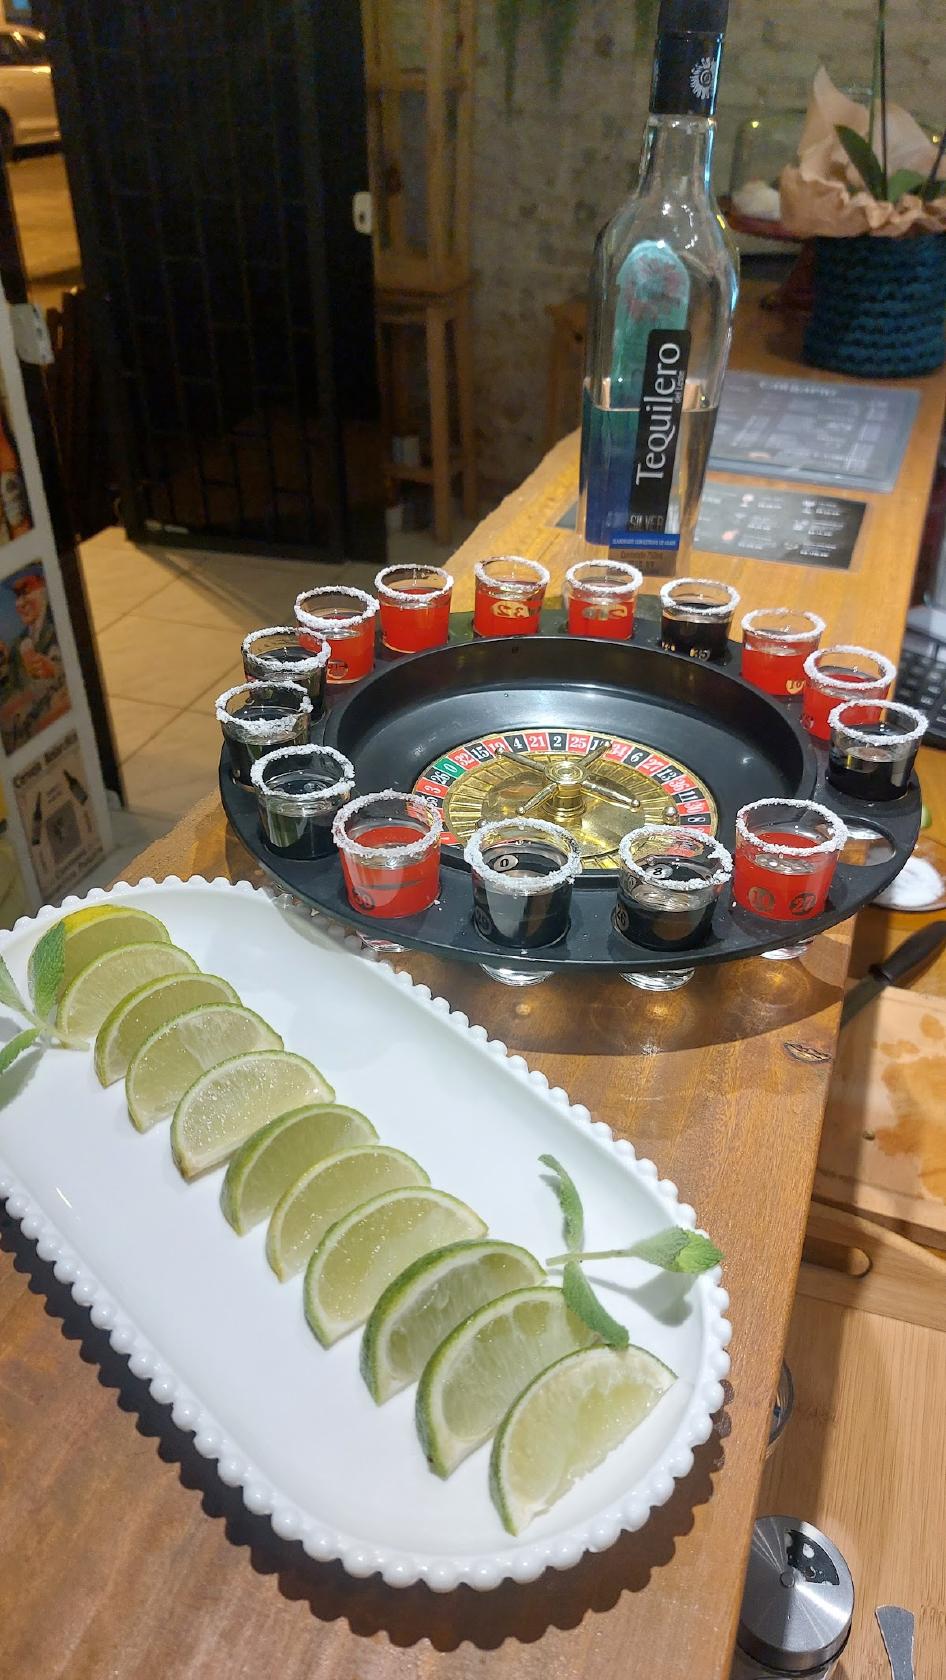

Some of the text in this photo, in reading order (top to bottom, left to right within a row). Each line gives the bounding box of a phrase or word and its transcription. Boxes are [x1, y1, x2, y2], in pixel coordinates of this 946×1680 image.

[513, 737, 523, 749] 4
[529, 735, 546, 747] 21
[553, 735, 562, 747] 2
[570, 736, 587, 749] 25
[456, 753, 475, 766] 32
[471, 746, 490, 761] 15
[630, 752, 643, 762] 6
[443, 763, 458, 773] 0
[641, 759, 664, 771] 27
[430, 771, 451, 785] 26
[656, 768, 677, 780] 13
[669, 778, 690, 793] 36
[679, 790, 699, 802] 11
